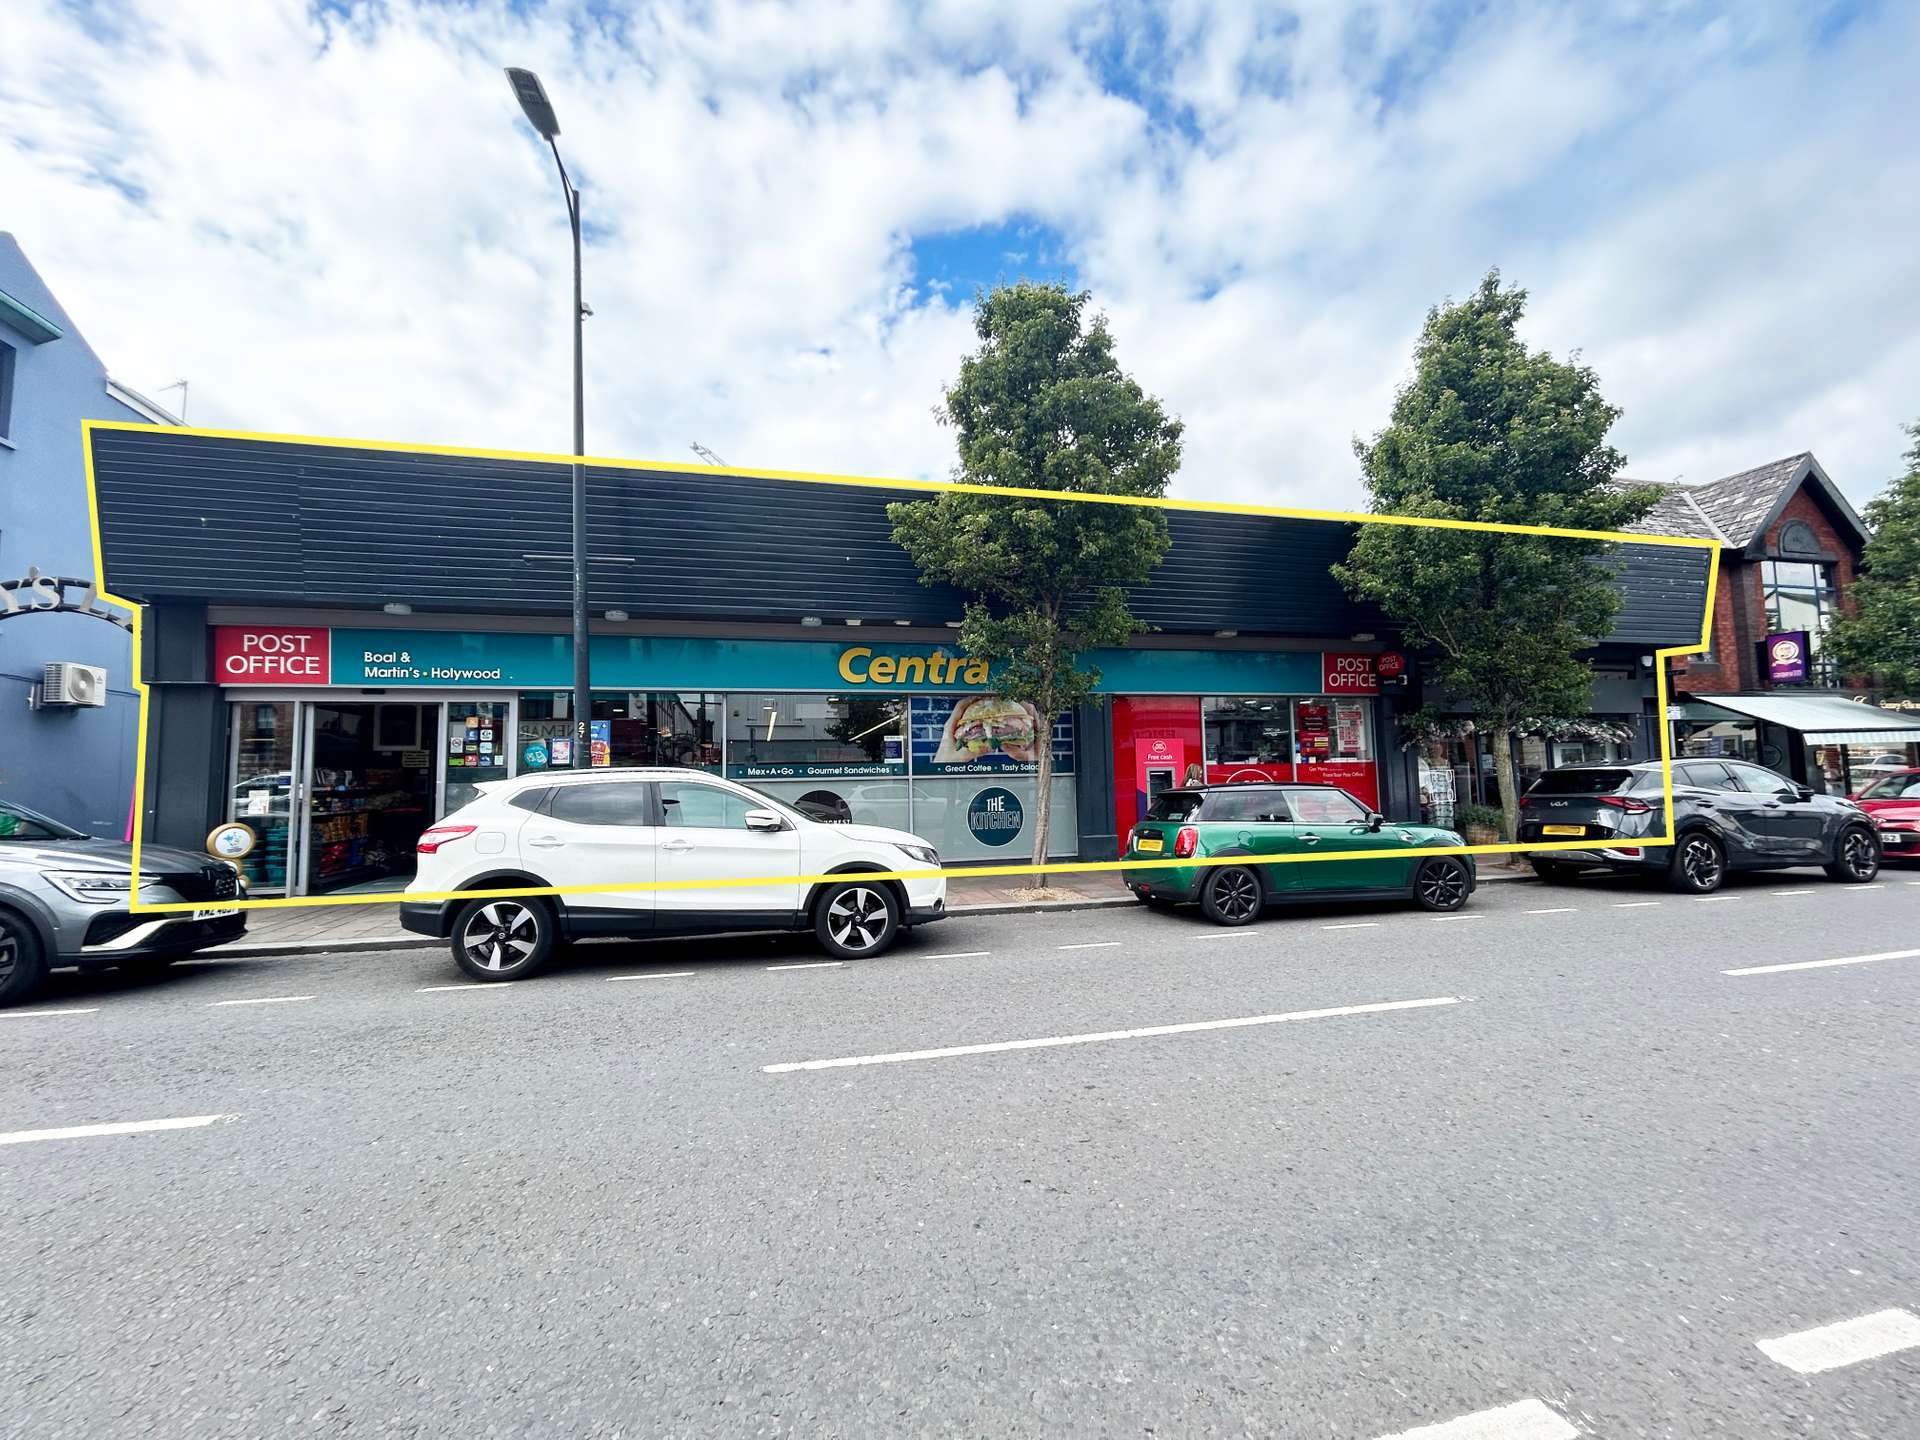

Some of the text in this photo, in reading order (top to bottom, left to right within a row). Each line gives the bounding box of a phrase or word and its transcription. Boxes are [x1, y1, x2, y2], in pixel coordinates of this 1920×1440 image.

[243, 634, 312, 653] POST
[364, 651, 411, 663] Boal &
[225, 655, 320, 674] OFFICE
[838, 647, 990, 685] Centra
[1337, 658, 1372, 672] POST
[364, 666, 501, 681] Martin's Holywood
[1328, 673, 1377, 687] OFFICE
[1147, 753, 1173, 761] Free cash
[807, 767, 841, 775] Gourmet
[843, 766, 890, 775] Sandwiches
[944, 765, 966, 773] Great
[967, 764, 992, 772] Coffee
[1002, 763, 1019, 772] Tasty
[986, 796, 1005, 811] THE
[970, 811, 1021, 829] KITCHEN
